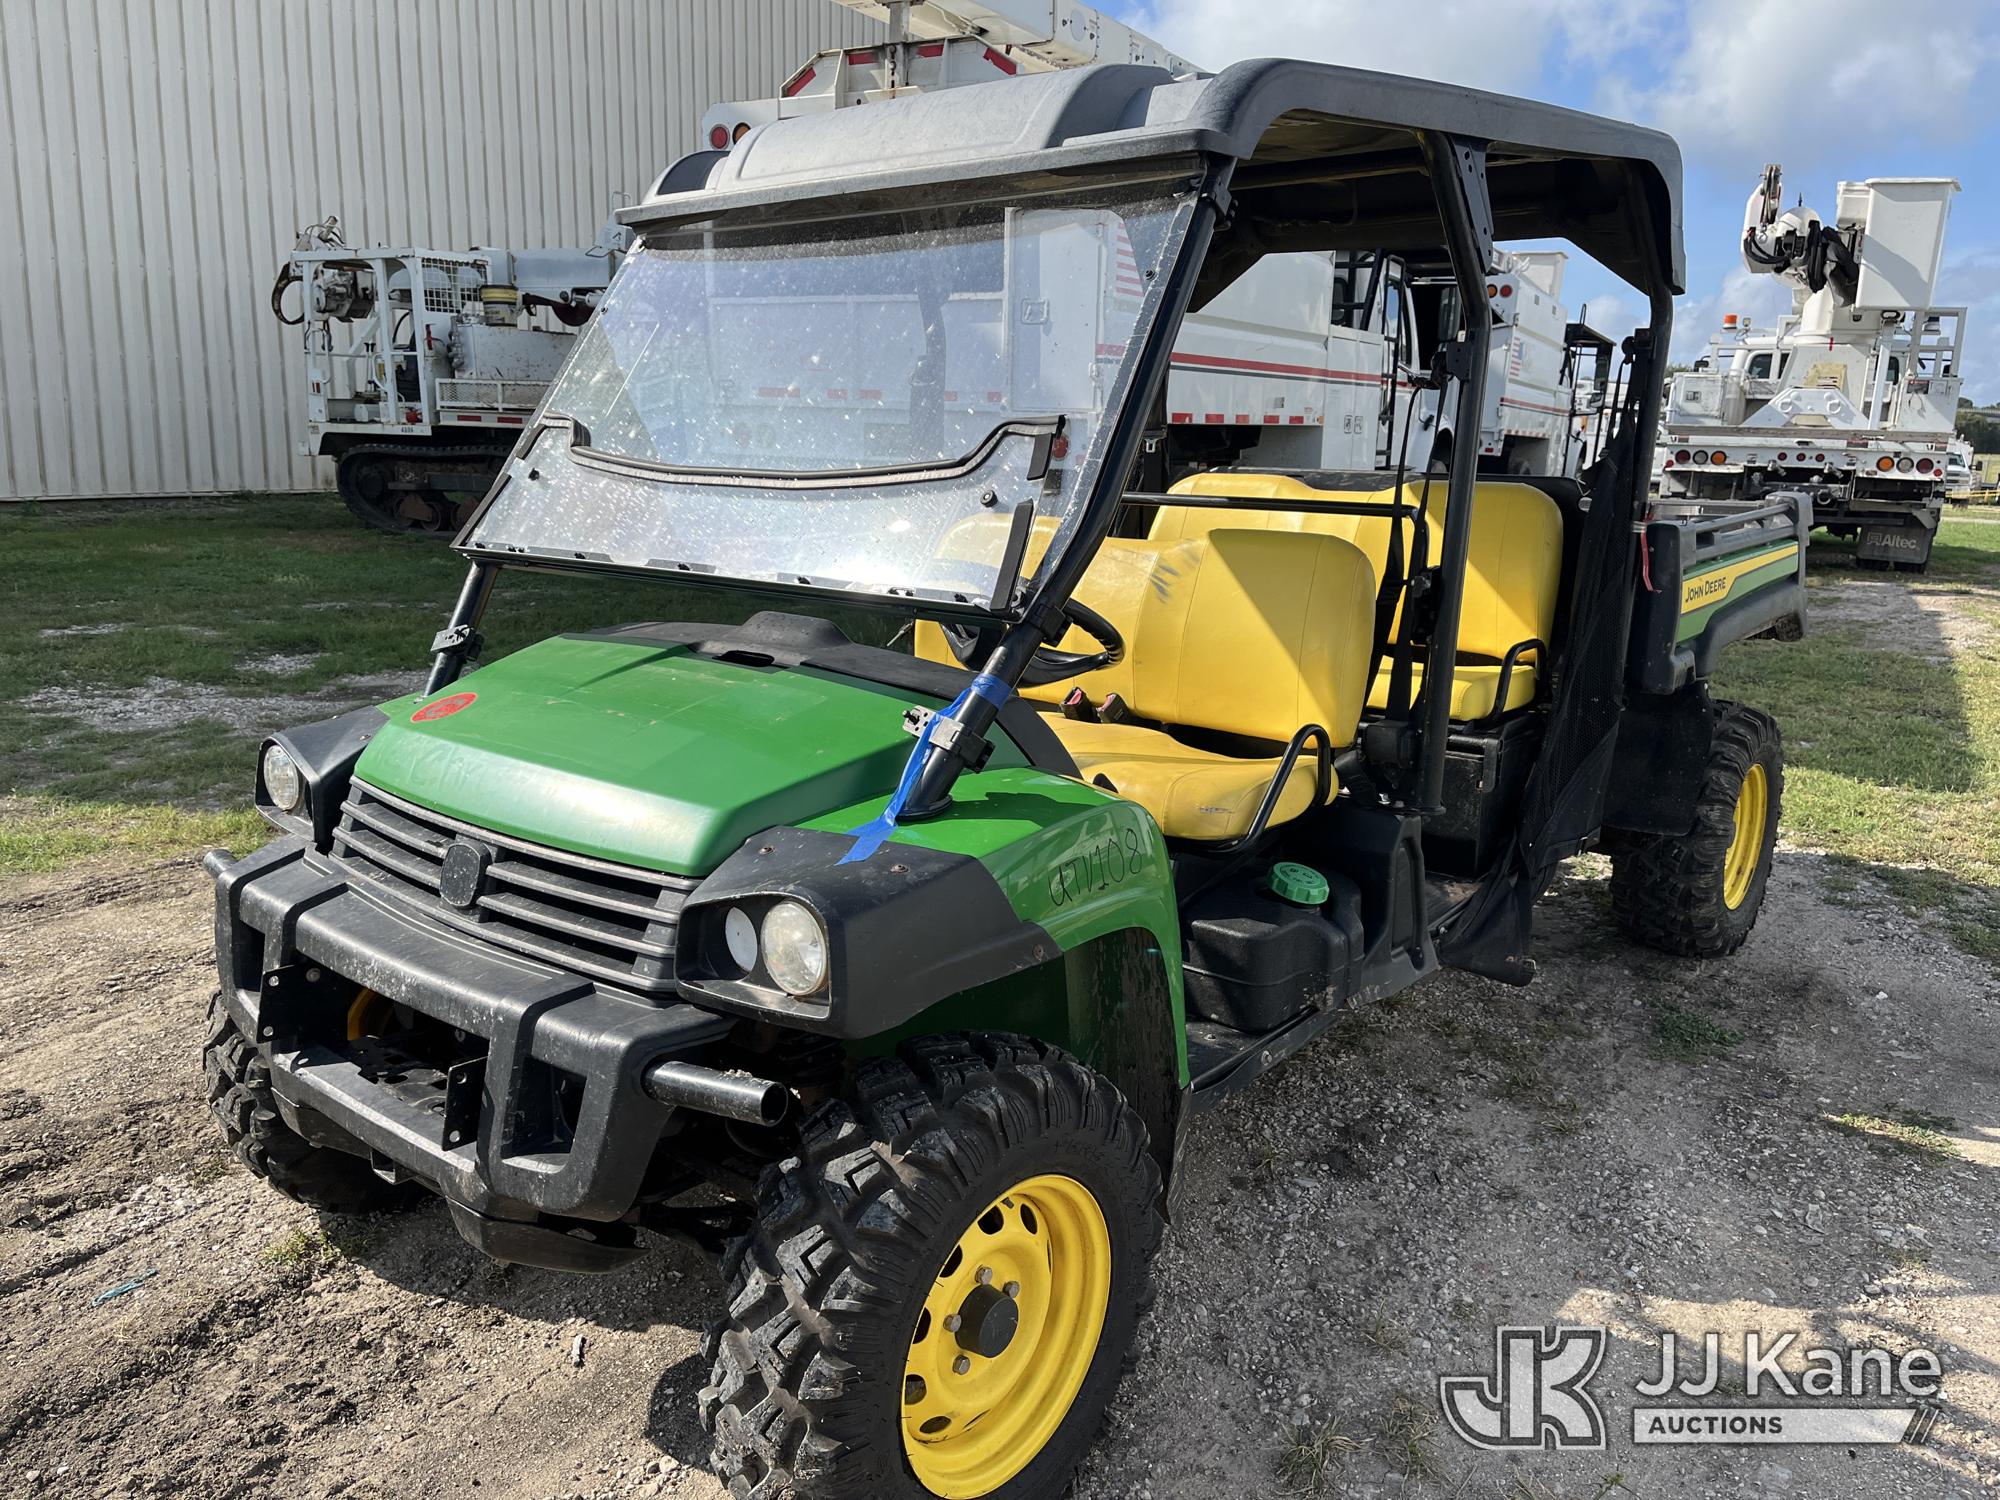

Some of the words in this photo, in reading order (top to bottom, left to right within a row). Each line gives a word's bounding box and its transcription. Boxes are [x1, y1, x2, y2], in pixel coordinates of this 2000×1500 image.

[1881, 534, 1917, 549] Altec
[1685, 586, 1704, 603] JOHN
[1704, 576, 1727, 596] DEERE
